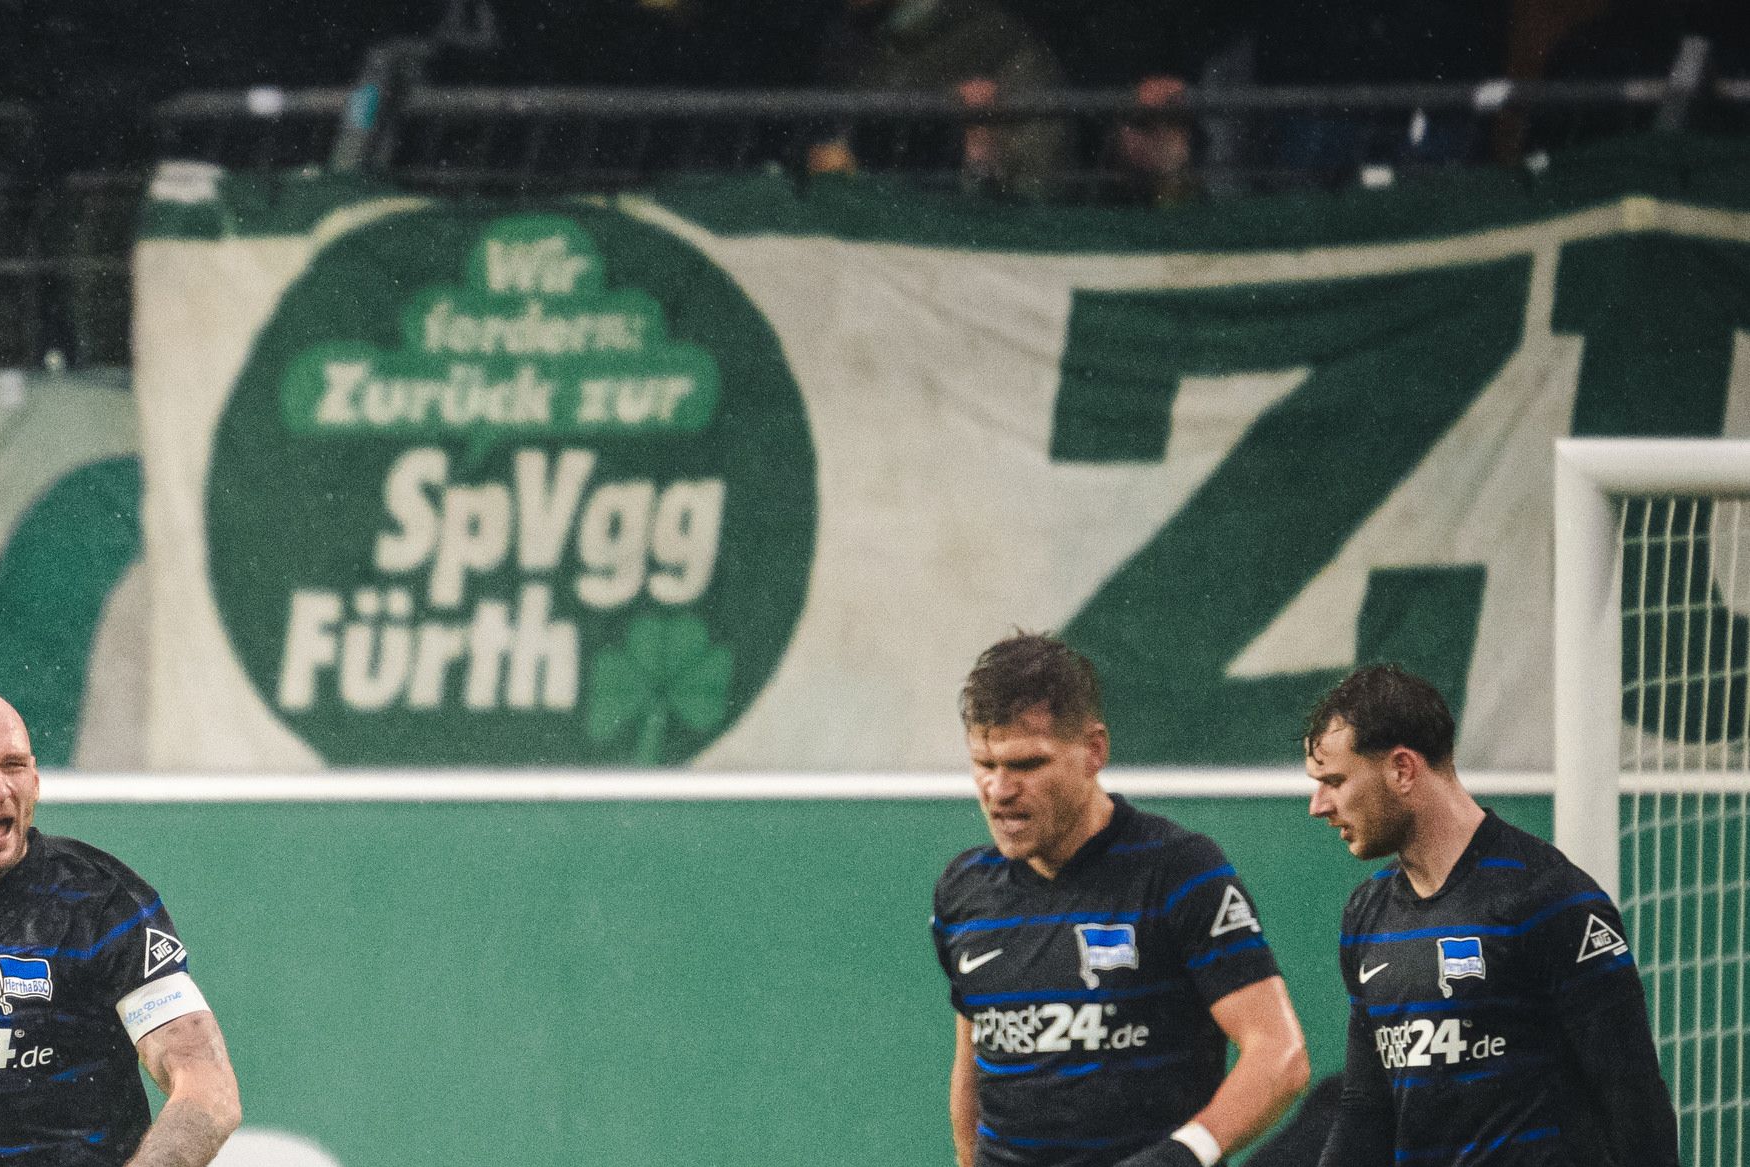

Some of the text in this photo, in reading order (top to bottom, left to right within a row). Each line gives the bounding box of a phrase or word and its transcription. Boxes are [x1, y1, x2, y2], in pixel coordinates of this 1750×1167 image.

[486, 237, 591, 294] Wir
[315, 362, 694, 425] Zurück zur
[375, 447, 725, 608] SpVgg
[278, 584, 580, 711] Fürth
